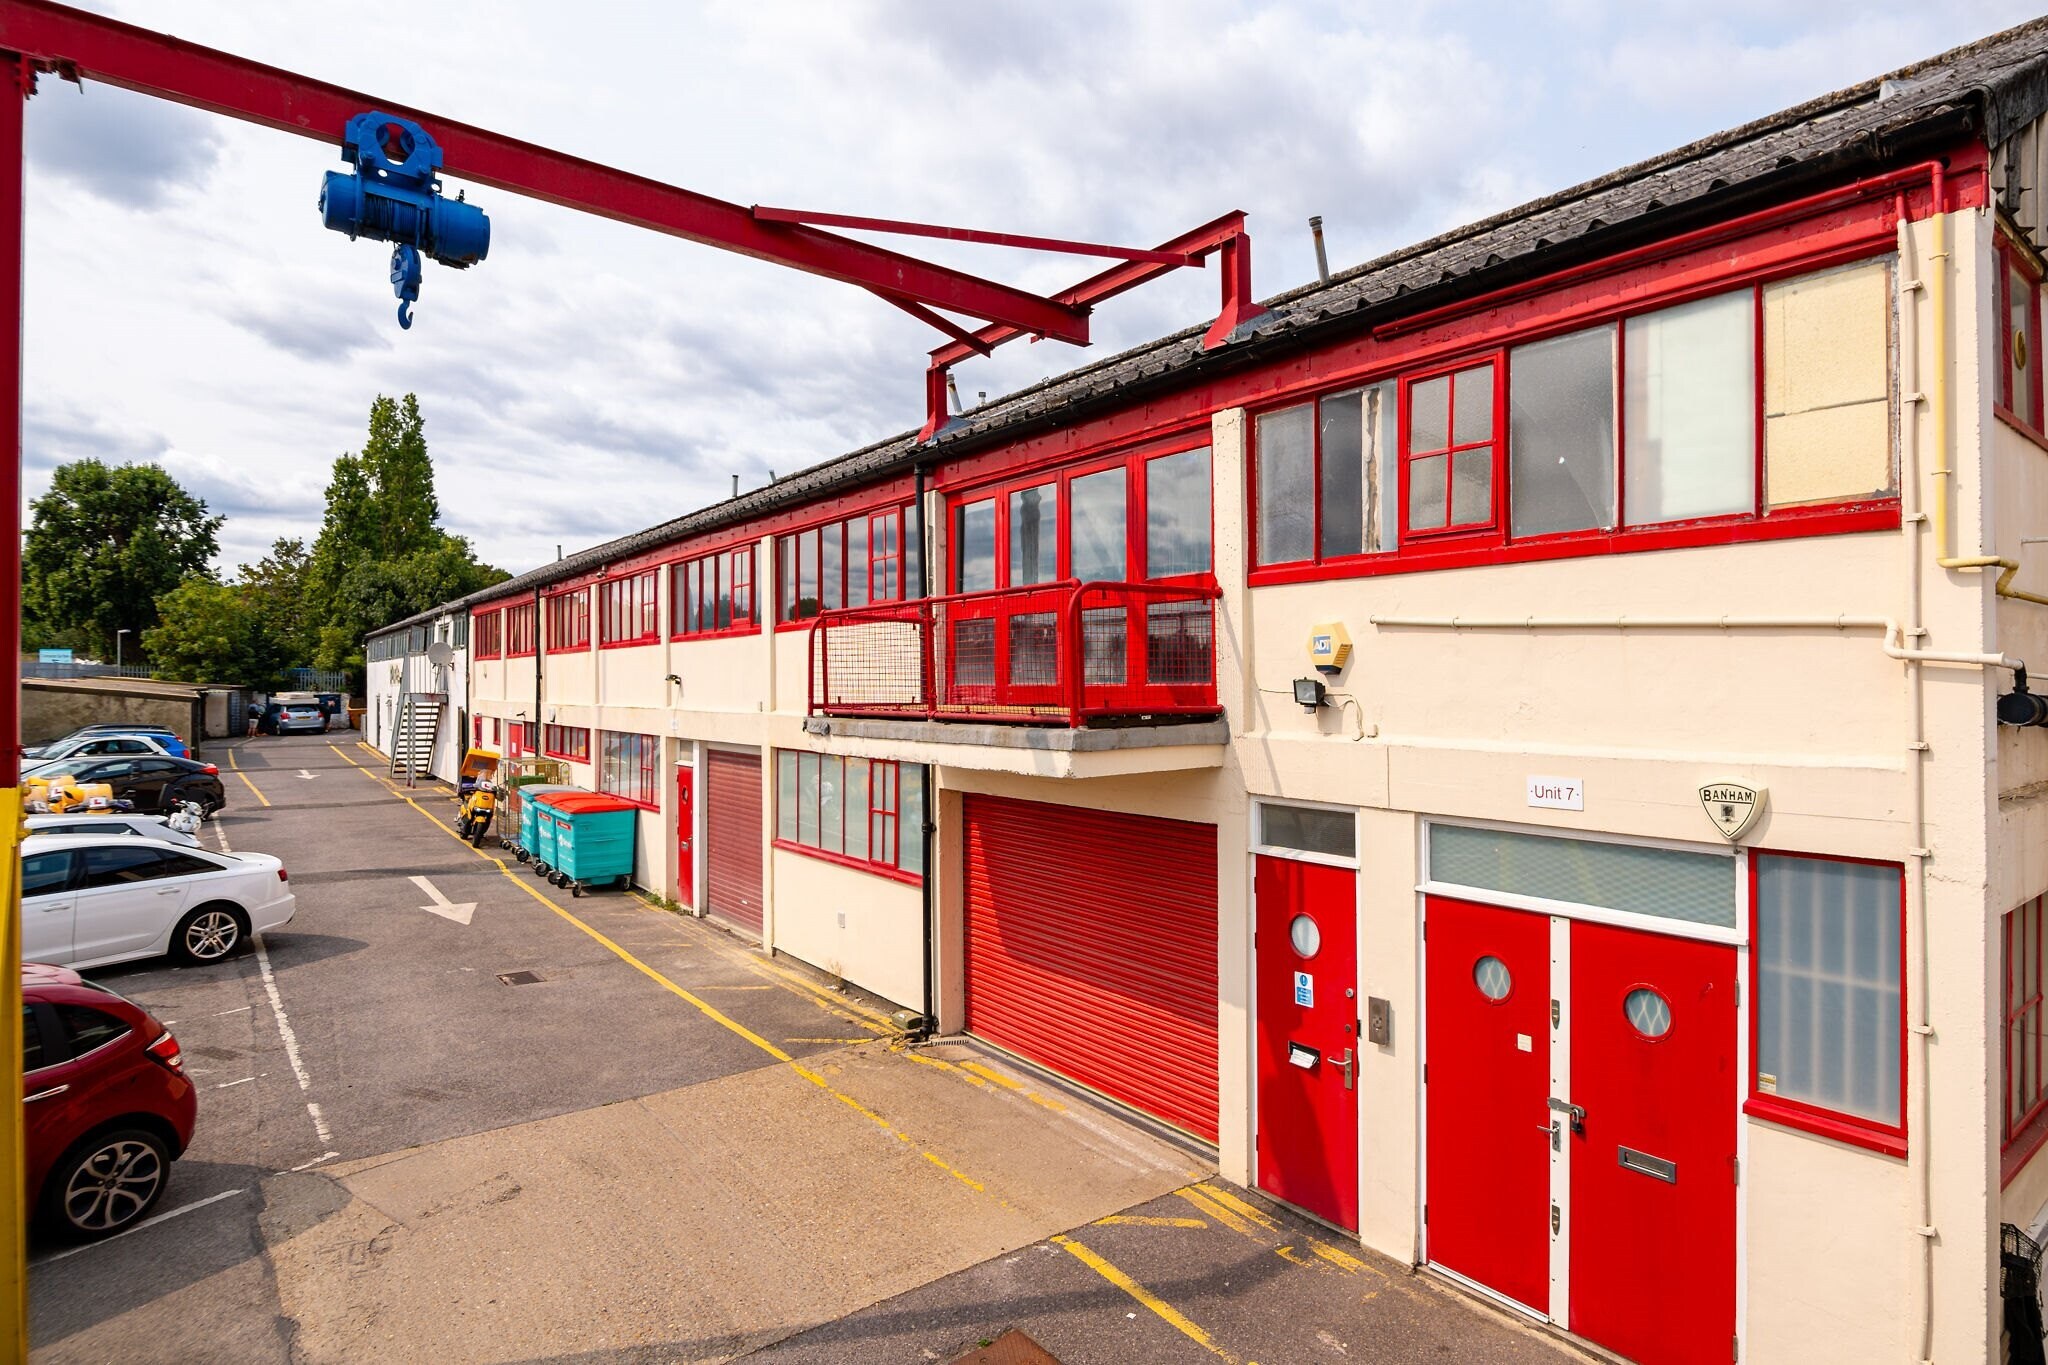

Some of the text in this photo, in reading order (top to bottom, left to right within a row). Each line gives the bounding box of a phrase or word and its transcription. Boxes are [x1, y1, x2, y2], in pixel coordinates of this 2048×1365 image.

[1313, 639, 1331, 651] ADT
[1534, 784, 1574, 801] Unit 7
[1703, 789, 1752, 802] BANHAM
